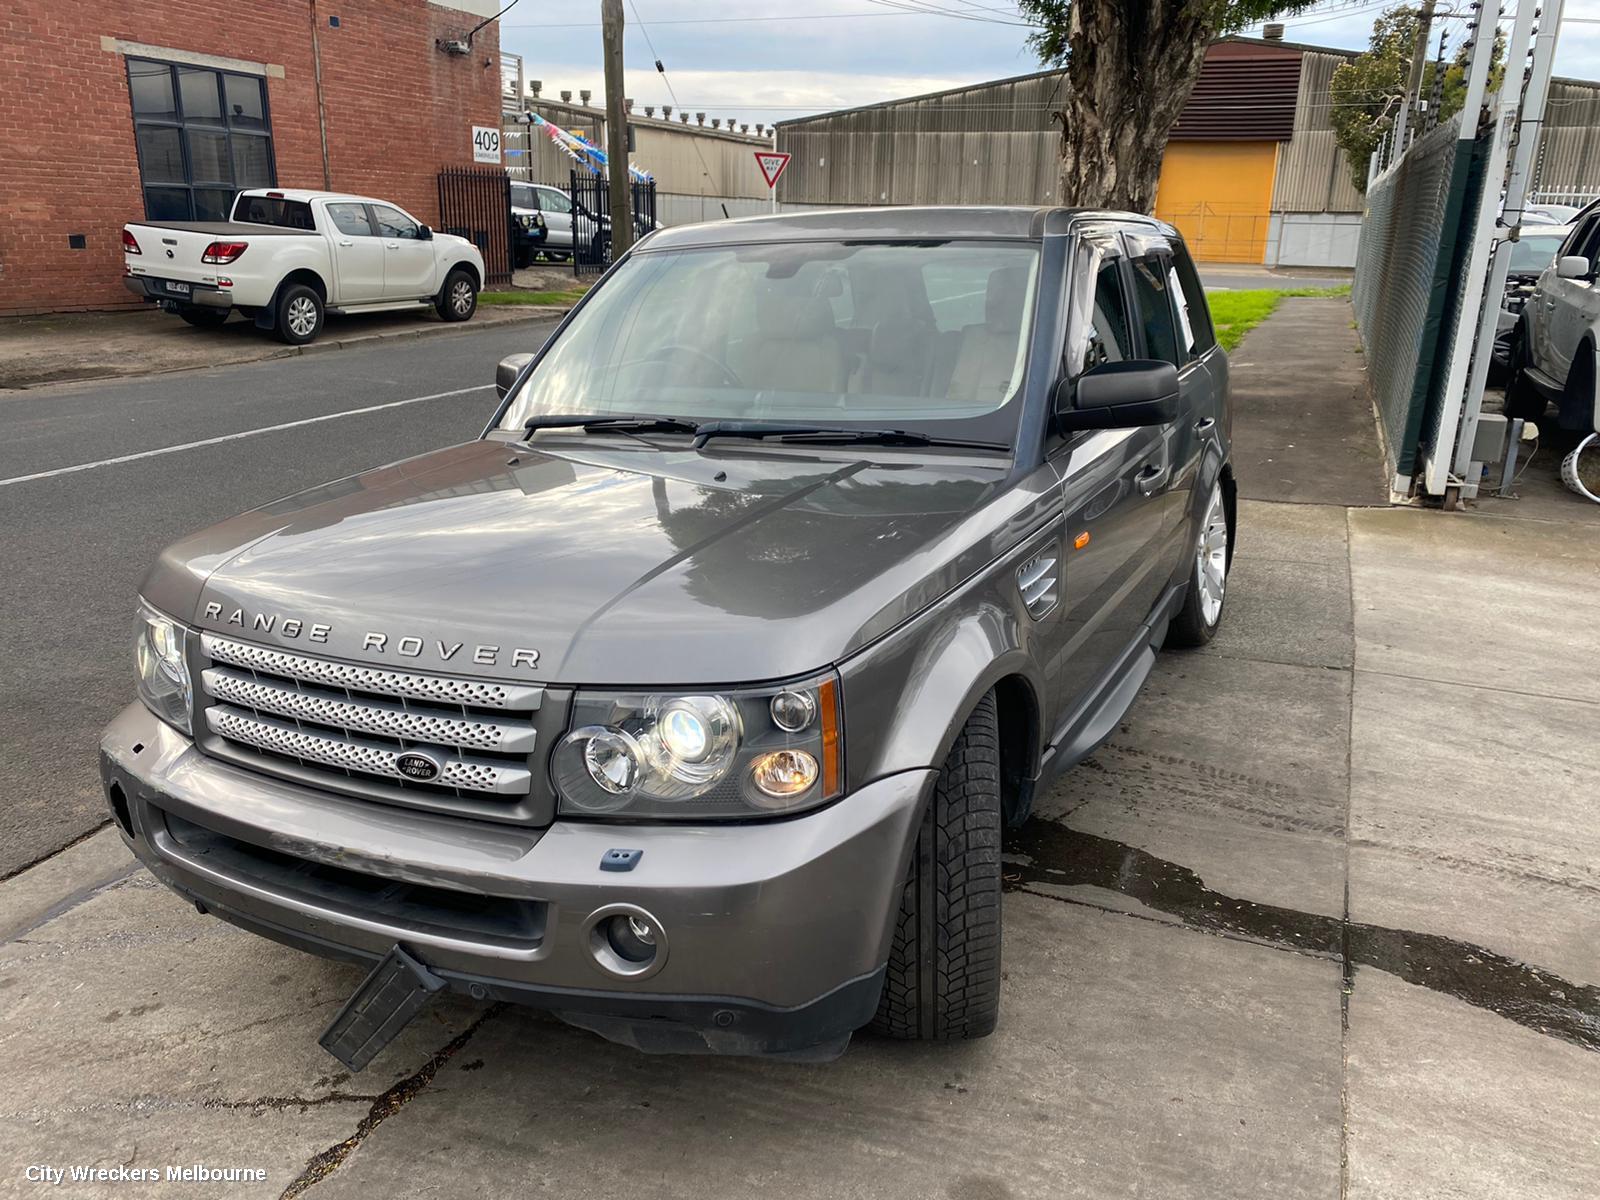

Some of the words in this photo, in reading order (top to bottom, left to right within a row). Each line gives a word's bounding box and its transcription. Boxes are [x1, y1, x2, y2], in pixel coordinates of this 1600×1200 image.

[475, 130, 499, 151] 409
[763, 158, 780, 166] GIVE
[204, 601, 333, 643] RANGE
[362, 631, 542, 670] ROVER
[404, 758, 425, 768] LAND
[405, 766, 432, 777] ROVER
